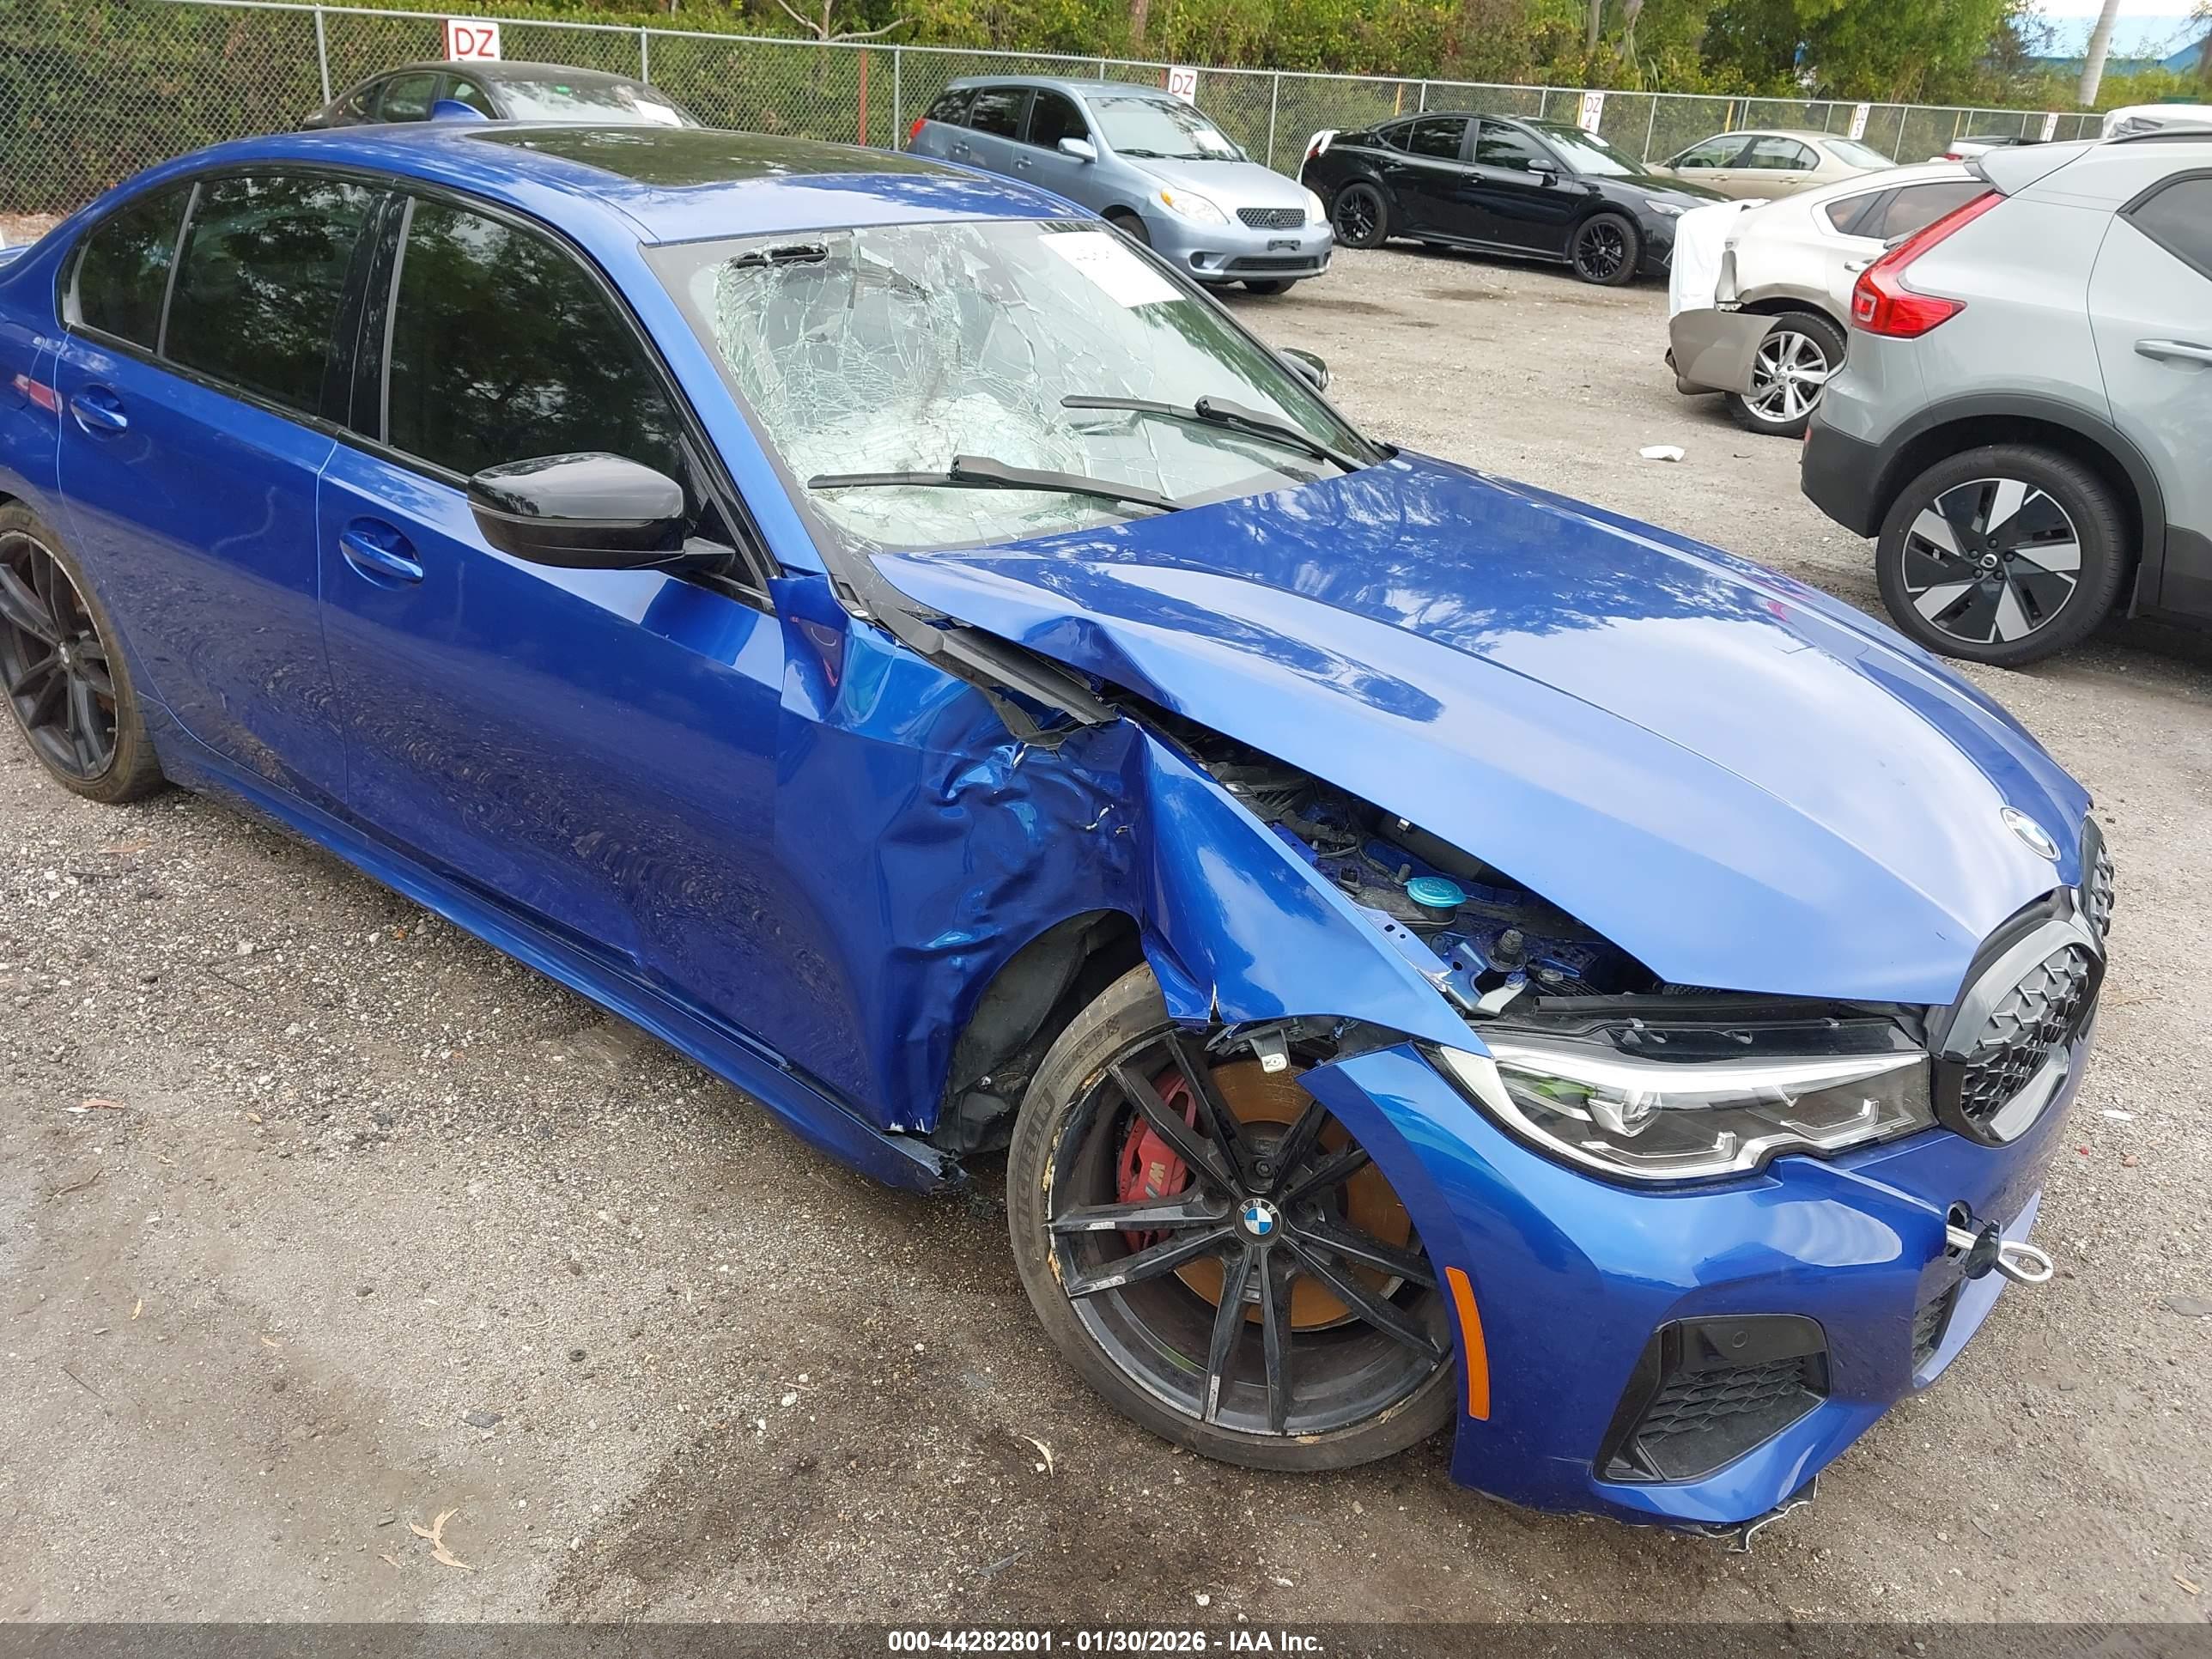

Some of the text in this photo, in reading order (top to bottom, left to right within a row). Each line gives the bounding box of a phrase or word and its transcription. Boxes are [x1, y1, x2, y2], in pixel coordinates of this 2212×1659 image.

[454, 27, 495, 58] DZ
[1171, 74, 1194, 95] DZ
[1585, 96, 1601, 113] DZ
[1239, 1199, 1278, 1215] BMW
